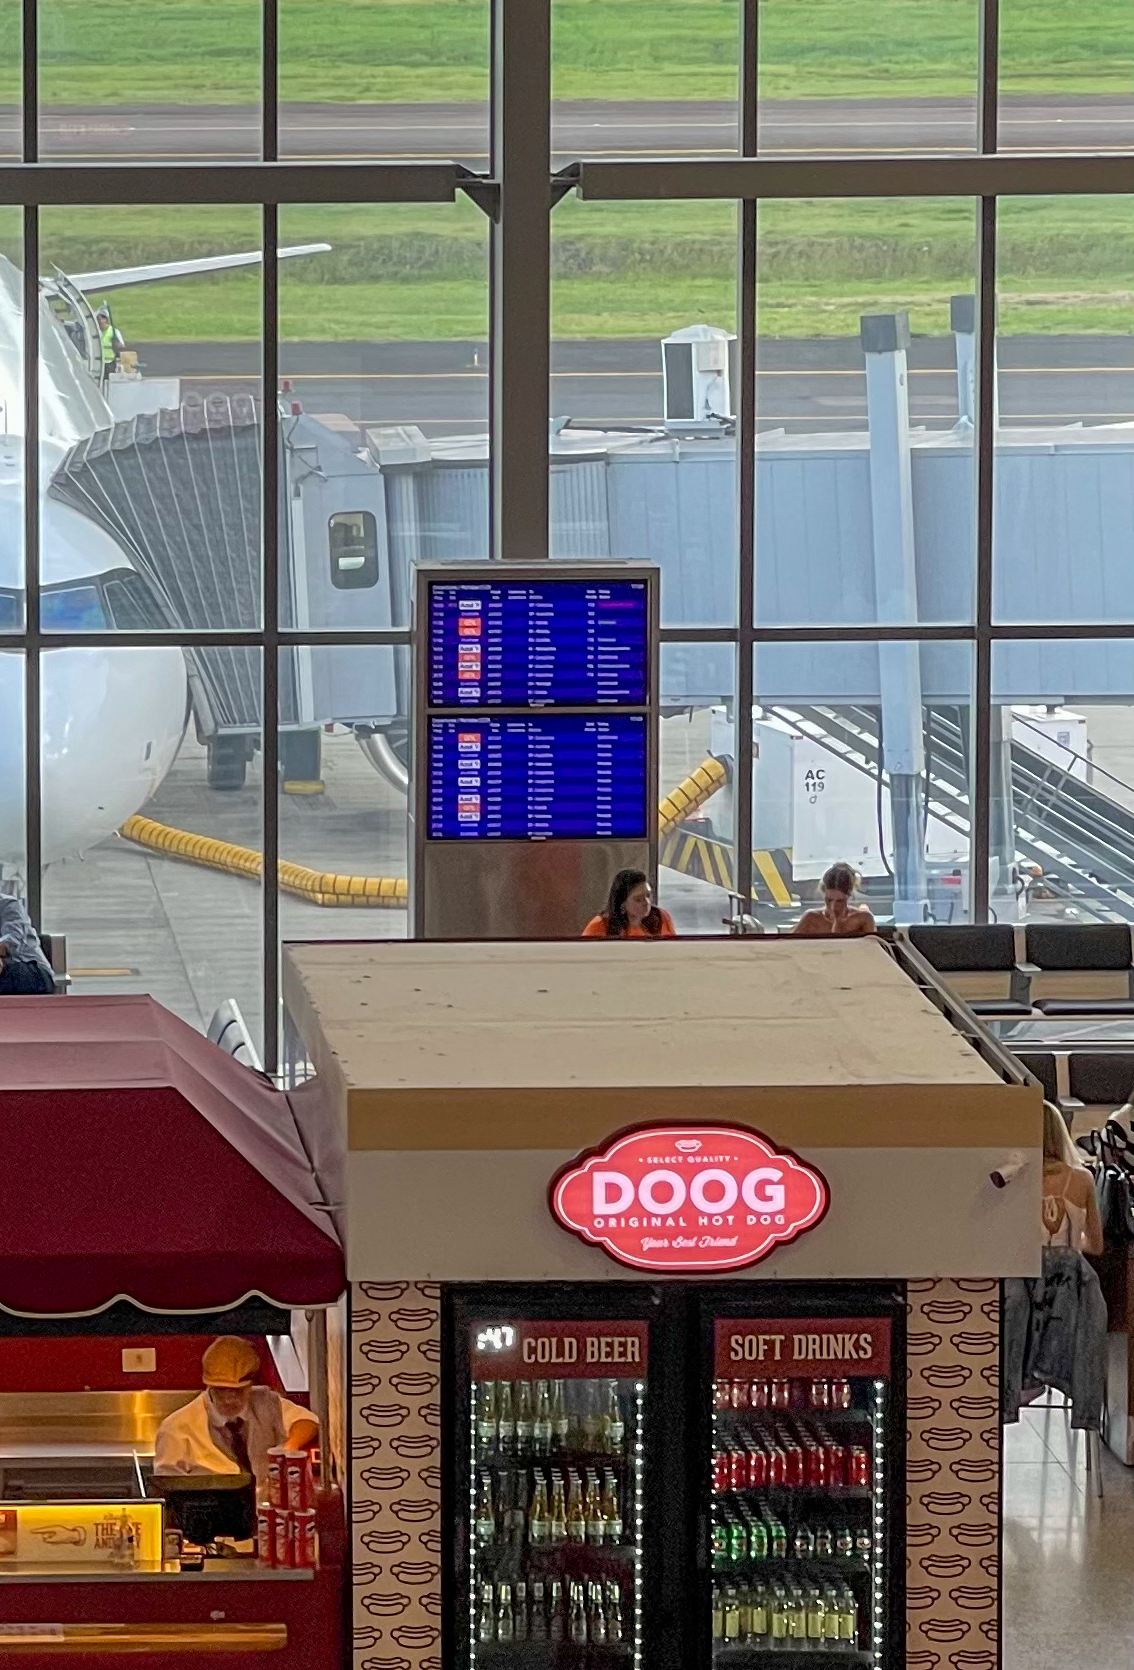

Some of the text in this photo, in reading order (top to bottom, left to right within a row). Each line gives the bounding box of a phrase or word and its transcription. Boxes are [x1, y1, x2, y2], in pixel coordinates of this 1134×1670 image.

[805, 769, 826, 781] AC
[805, 781, 825, 792] 119
[646, 1155, 731, 1164] SELECT QUALITY
[592, 1167, 785, 1215] DOOG
[593, 1214, 785, 1229] ORIGINAL HOT DOG
[640, 1236, 670, 1251] Your
[698, 1235, 739, 1248] Friend
[522, 1336, 640, 1363] COLD BEER
[730, 1333, 872, 1361] SOFT DRINKS
